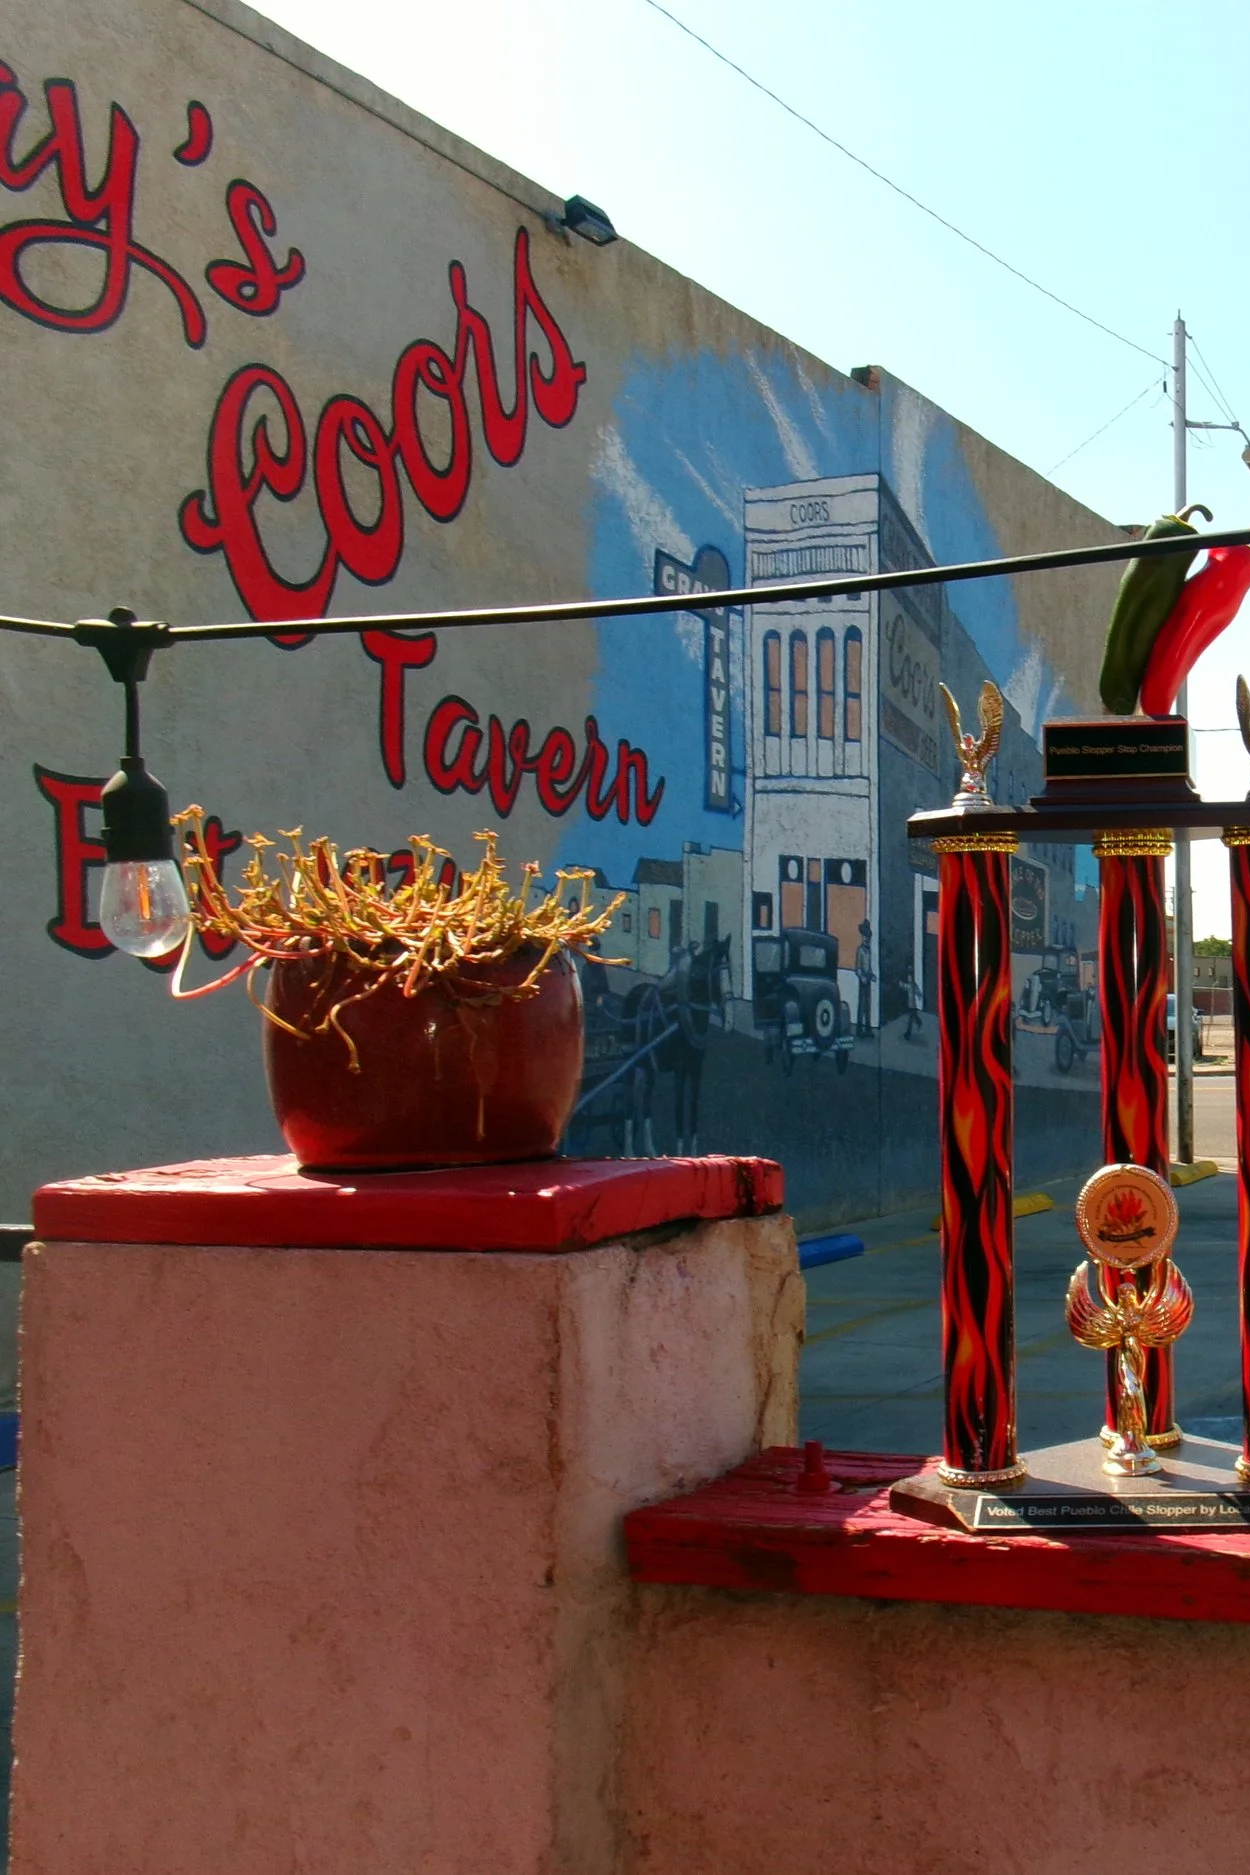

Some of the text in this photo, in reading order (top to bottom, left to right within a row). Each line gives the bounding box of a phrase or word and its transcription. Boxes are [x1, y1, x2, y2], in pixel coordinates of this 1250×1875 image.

[178, 225, 587, 650] Coors
[790, 500, 830, 525] COORS
[359, 628, 665, 827] Tavern
[710, 625, 726, 797] TAVERN
[1140, 743, 1184, 754] Champion
[987, 1506, 1025, 1516] Voted
[1028, 1505, 1057, 1516] Best
[1061, 1505, 1106, 1516] Pueblo
[1146, 1504, 1197, 1517] Slopper
[1200, 1504, 1216, 1517] by
